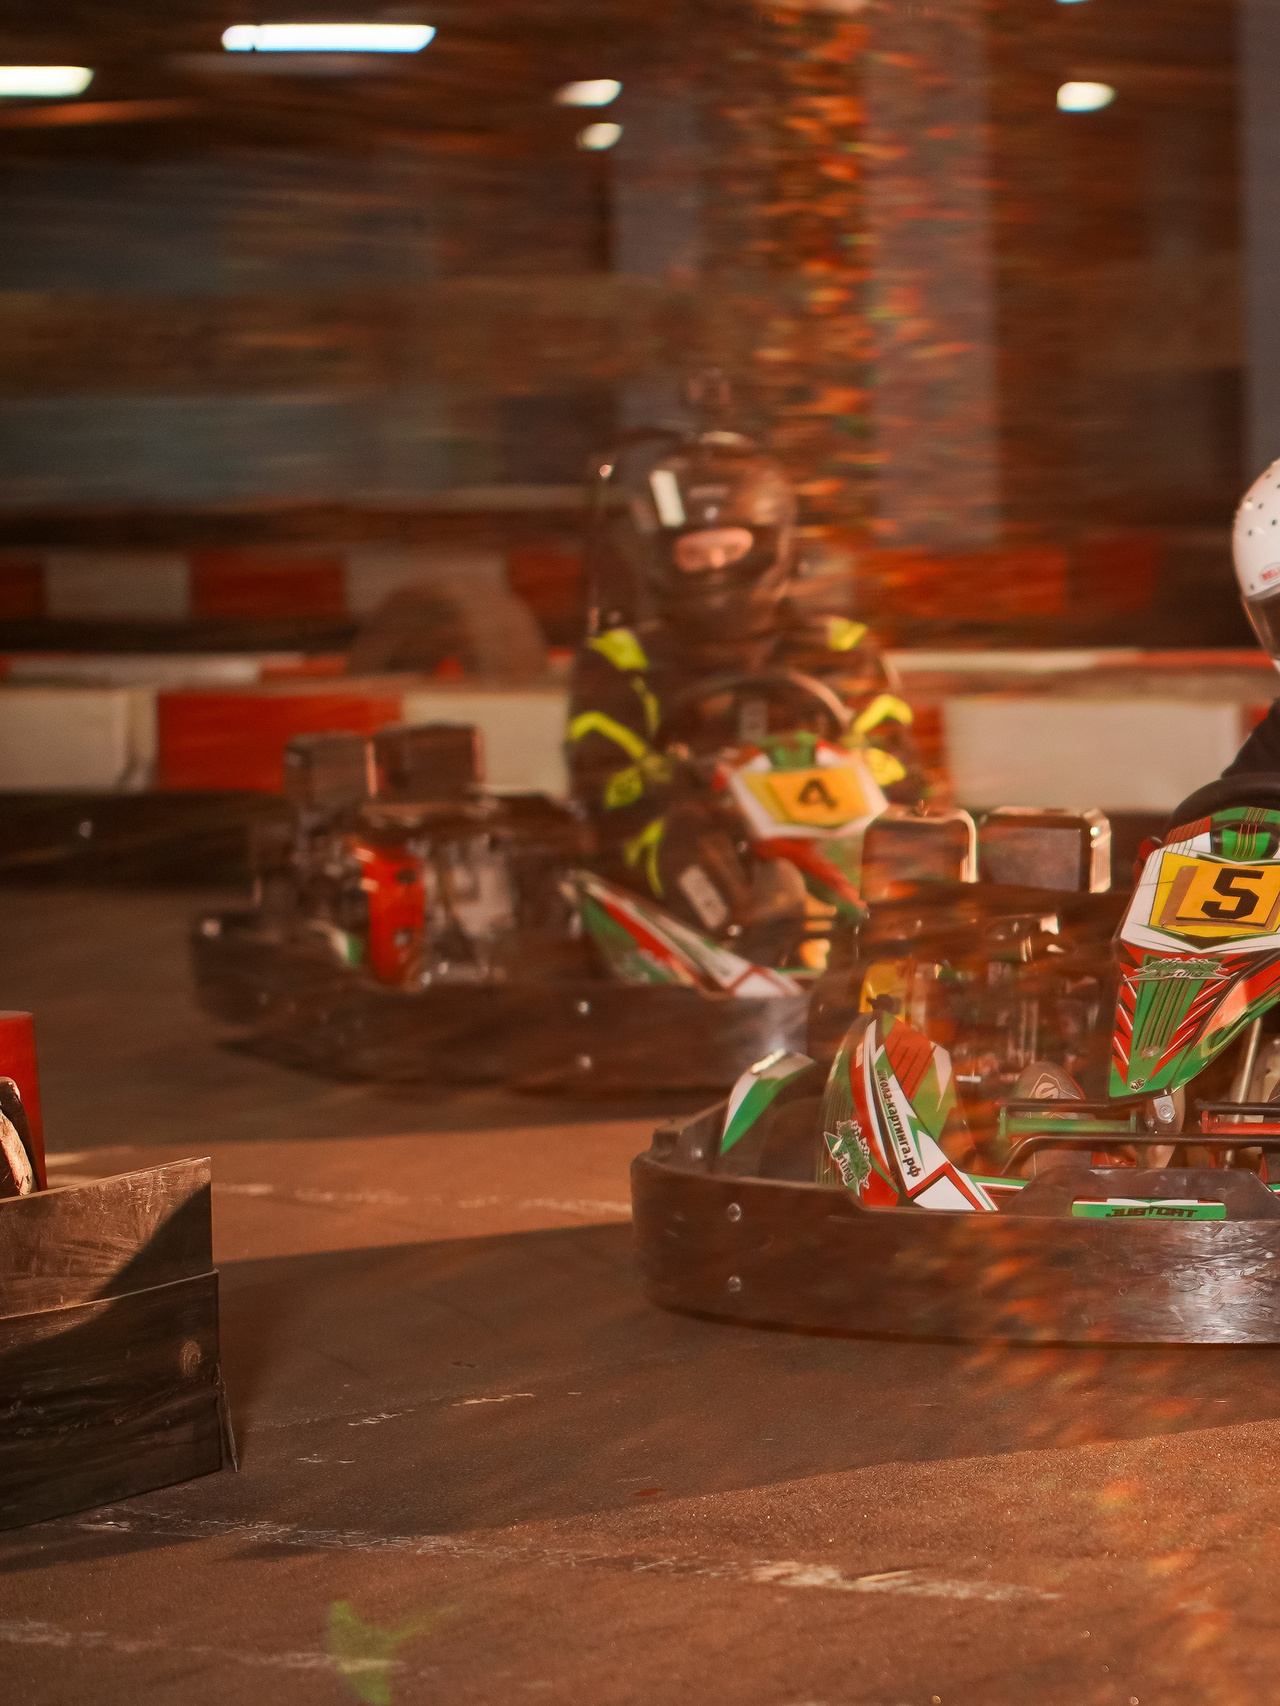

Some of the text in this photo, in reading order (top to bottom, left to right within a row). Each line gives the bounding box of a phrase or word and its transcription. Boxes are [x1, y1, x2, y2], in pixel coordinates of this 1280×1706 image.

[798, 778, 837, 810] 4
[1200, 867, 1265, 919] 5
[877, 1069, 921, 1178] школа-картинга.рф
